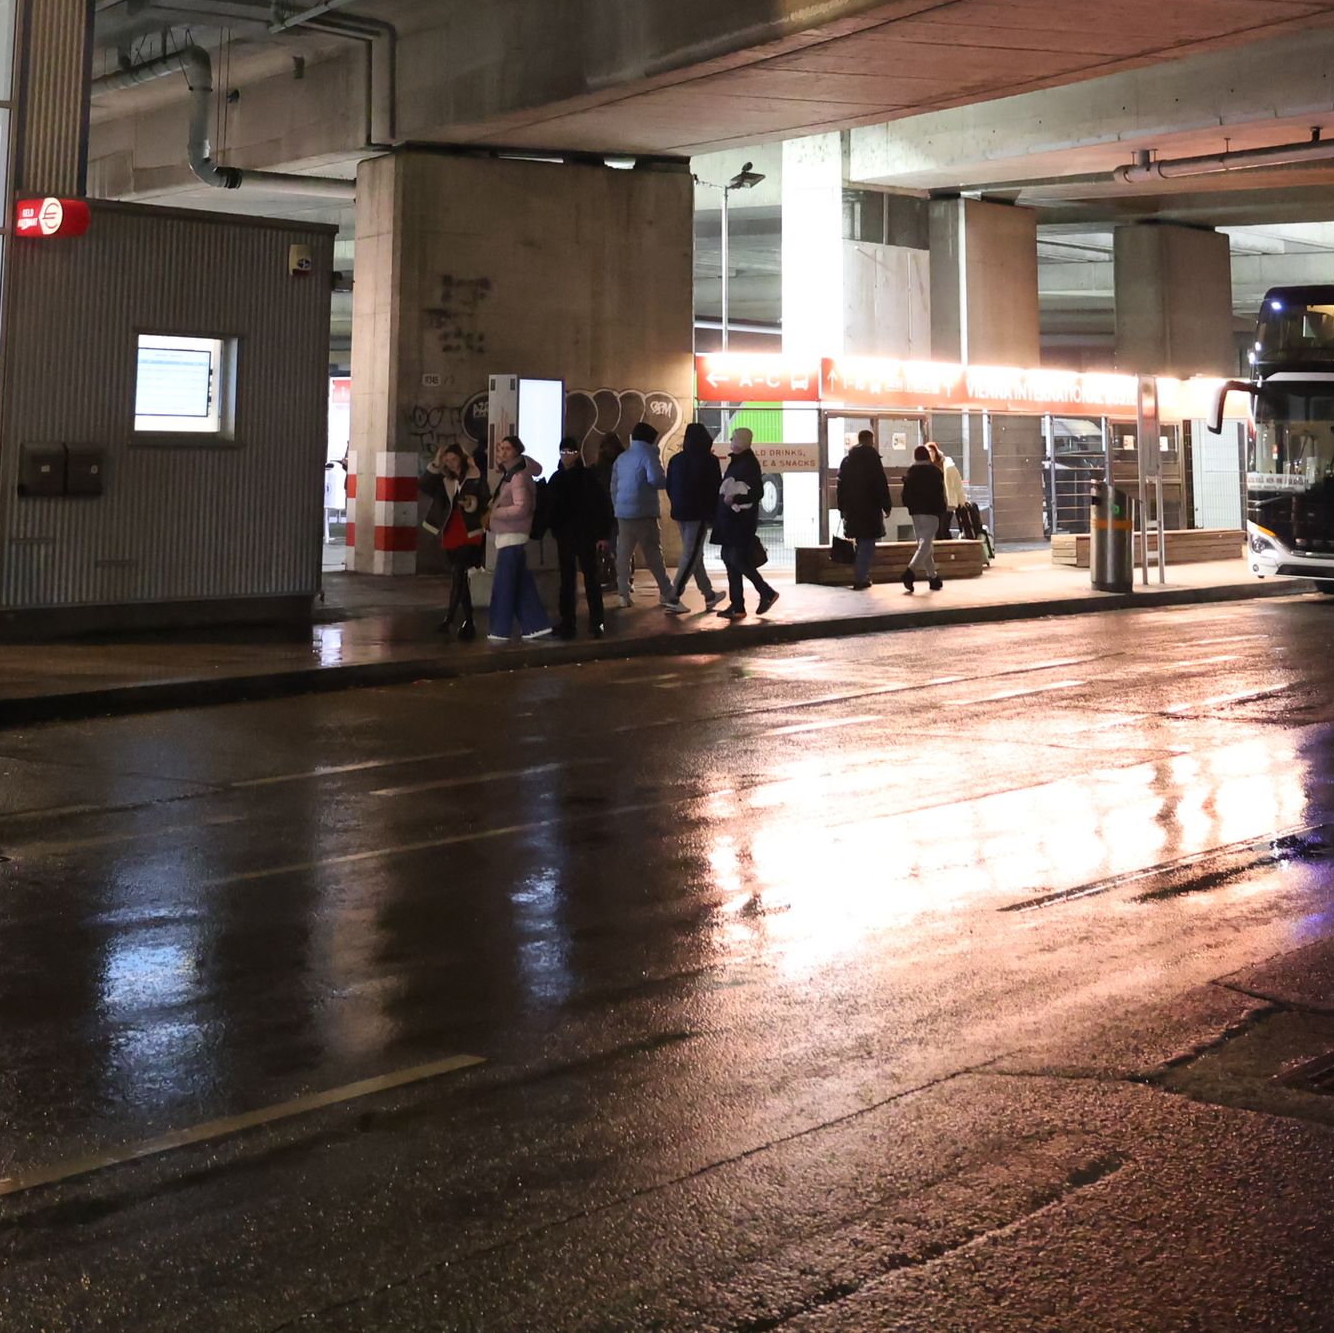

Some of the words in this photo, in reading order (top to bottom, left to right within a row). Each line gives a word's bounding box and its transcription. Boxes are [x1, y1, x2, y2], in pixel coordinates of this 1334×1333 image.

[755, 449, 766, 457] LD
[769, 449, 806, 457] DRINKS,
[780, 459, 816, 468] SNACKS
